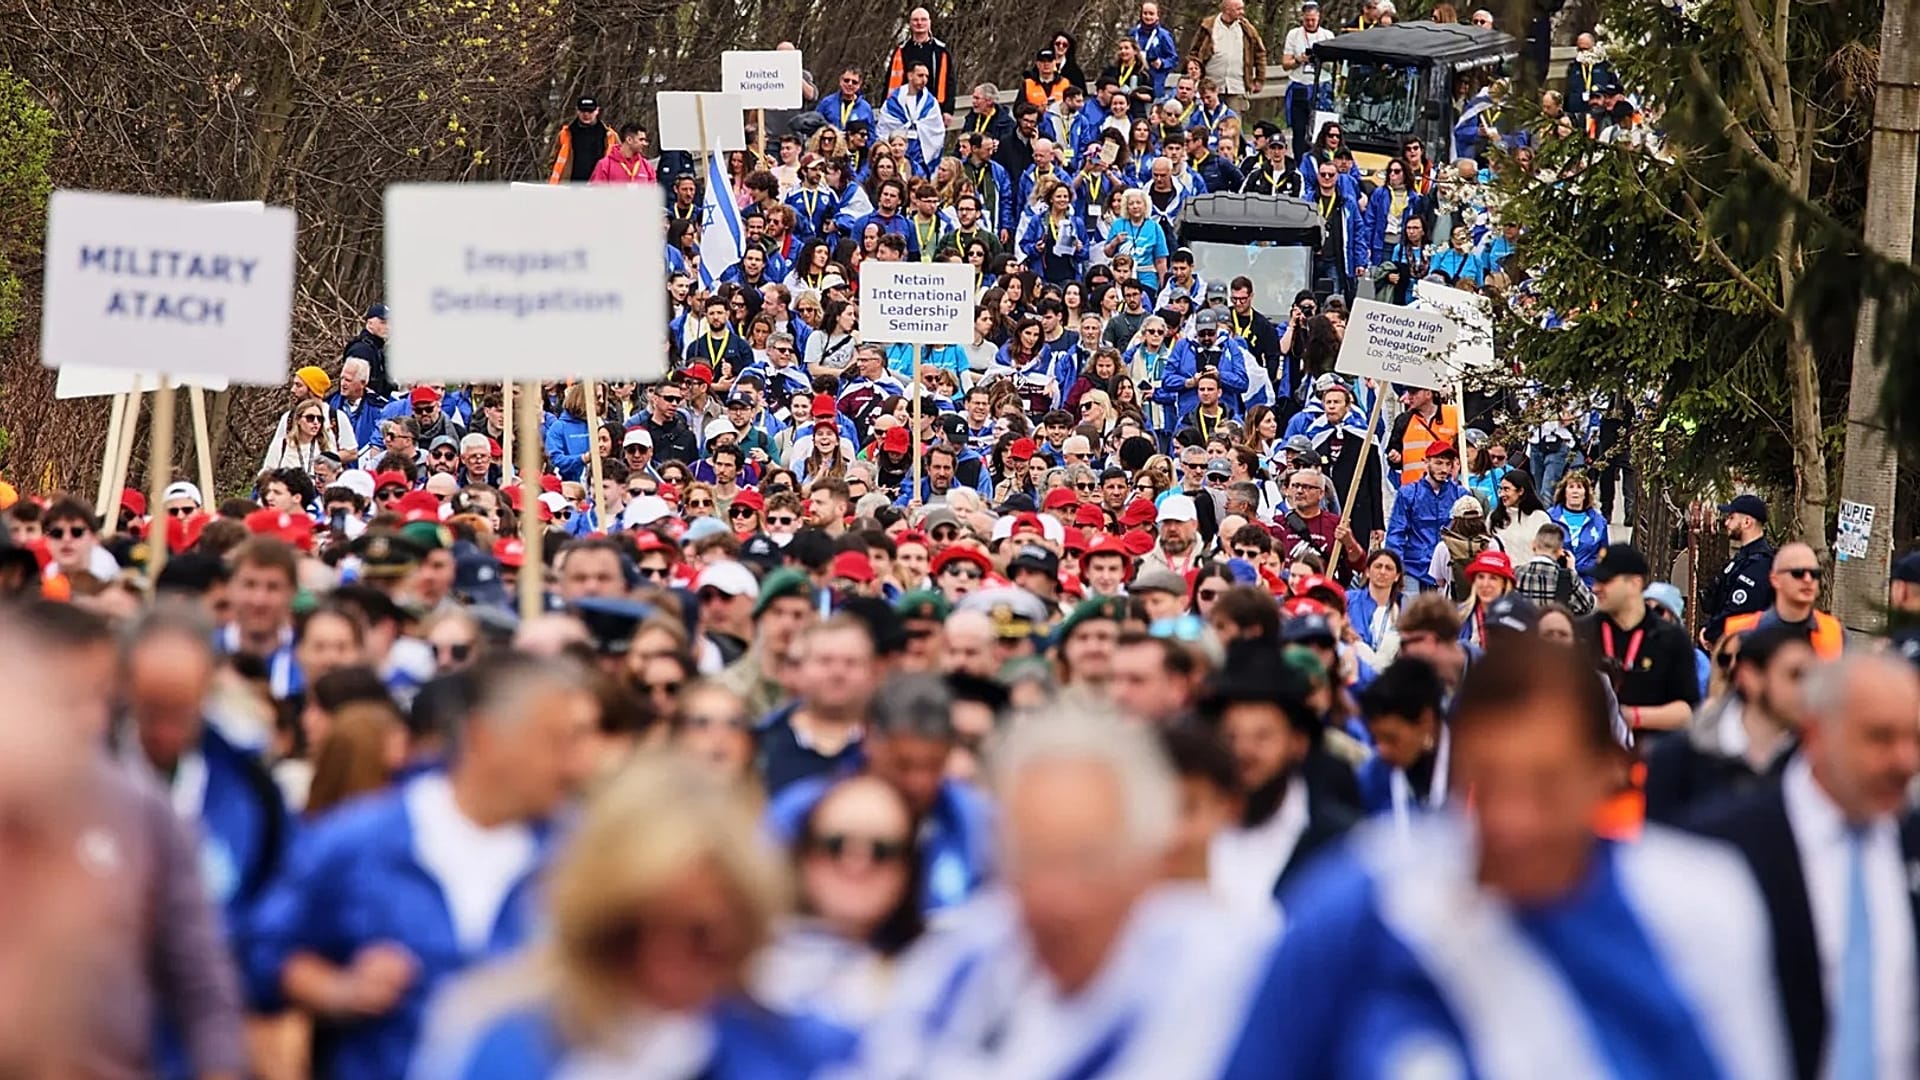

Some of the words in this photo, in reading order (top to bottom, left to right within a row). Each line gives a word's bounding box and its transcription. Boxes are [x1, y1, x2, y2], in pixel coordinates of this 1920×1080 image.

[746, 70, 779, 79] United
[740, 82, 784, 91] Kingdom
[79, 245, 258, 283] MILITARY
[893, 274, 945, 285] Netaim
[430, 286, 624, 319] Delegation
[872, 288, 967, 302] International
[107, 290, 226, 325] ATACH
[879, 303, 959, 319] Leadership
[889, 319, 949, 332] Seminar
[1366, 311, 1415, 328] deToledo
[1418, 320, 1443, 333] High
[1367, 323, 1403, 338] School
[1406, 331, 1435, 344] Adult
[1367, 347, 1383, 357] Los
[1386, 350, 1423, 365] Angeles
[1382, 361, 1401, 373] USA
[1841, 502, 1873, 522] KUPIE
